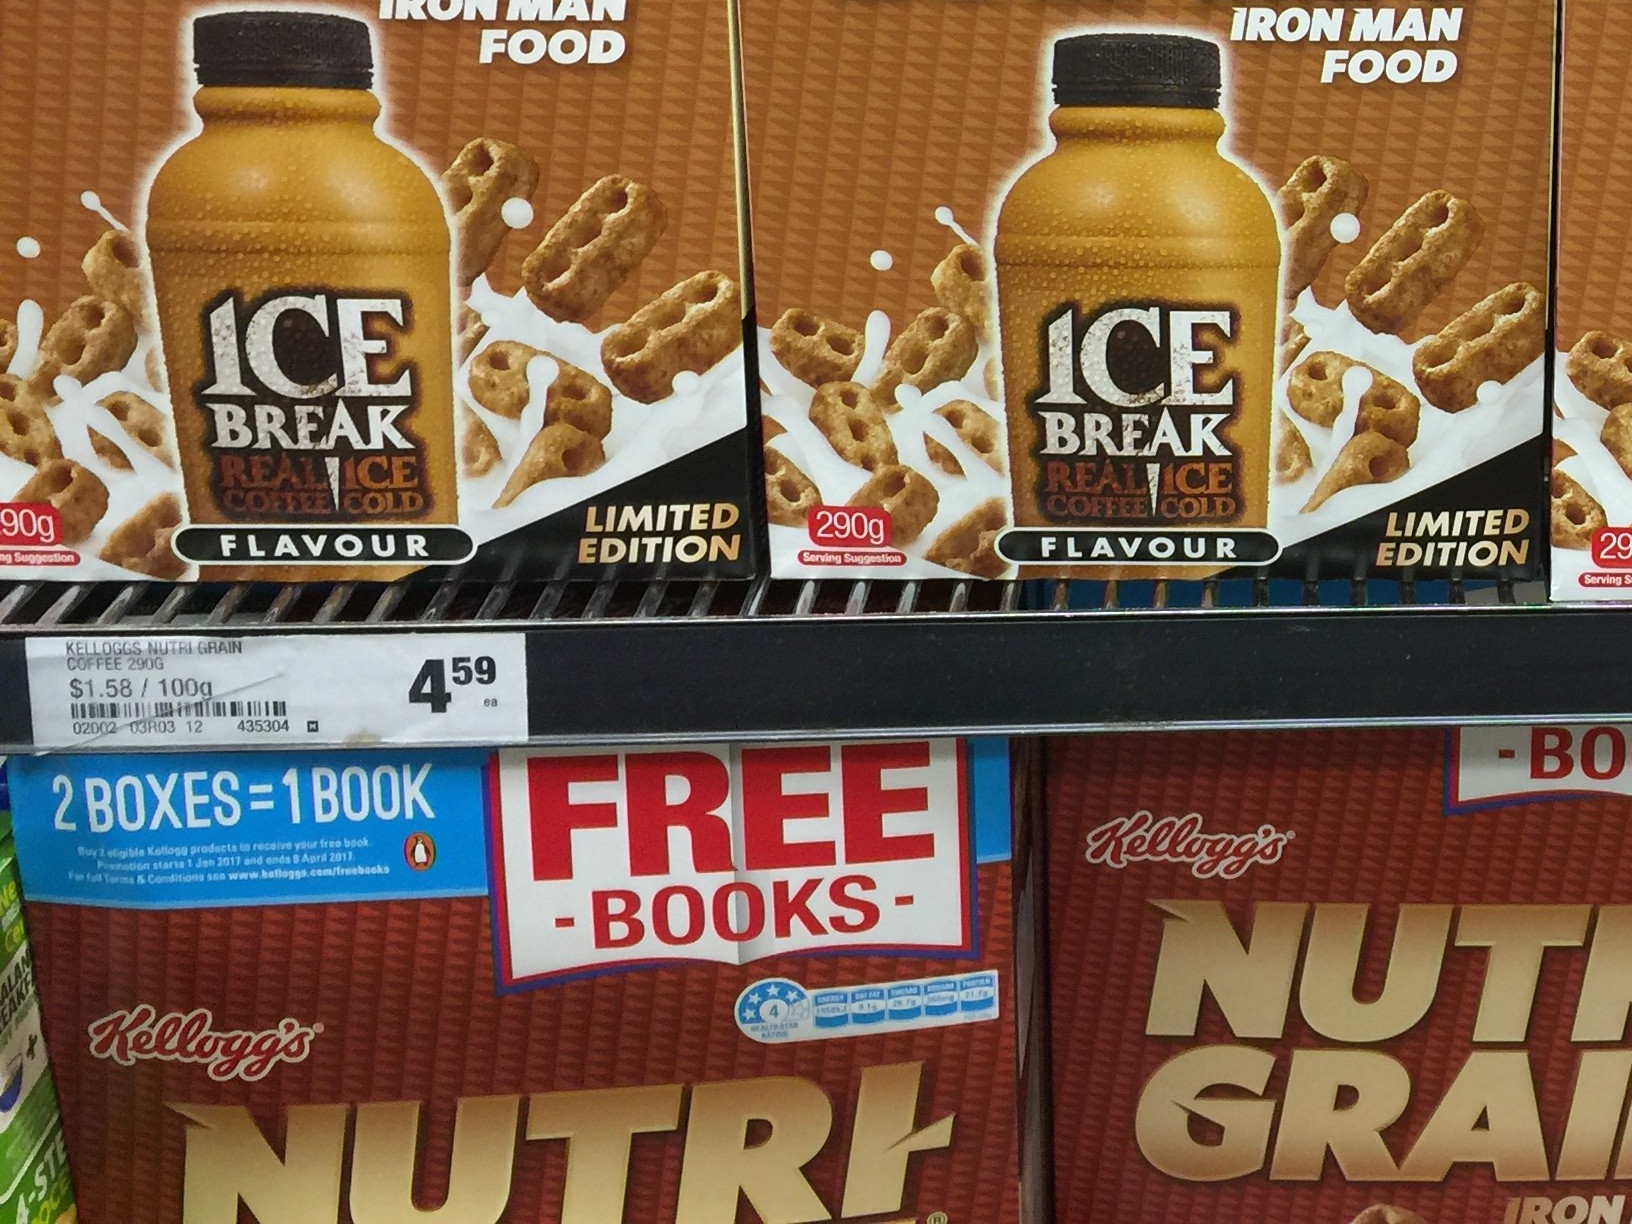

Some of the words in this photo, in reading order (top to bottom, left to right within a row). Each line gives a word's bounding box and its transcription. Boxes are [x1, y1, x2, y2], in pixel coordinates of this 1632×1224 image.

[1229, 6, 1348, 42] IRON
[1348, 6, 1463, 42] MAN
[479, 29, 627, 65] FOOD
[1320, 47, 1458, 84] FOOD
[202, 295, 413, 399] ICE
[1034, 307, 1239, 409] ICE
[212, 400, 416, 451] BREAK
[1037, 410, 1234, 460] BREAK
[1045, 460, 1147, 497] REAL
[1161, 460, 1234, 495] ICE
[585, 503, 740, 535] LIMITED
[1046, 493, 1149, 519] COFFEE
[1159, 493, 1237, 519] COLD
[0, 508, 55, 543] 90g
[815, 511, 885, 547] 290g
[1385, 509, 1530, 539] LIMITED
[14, 552, 75, 564] Suggestion
[220, 532, 430, 559] FLAVOUR
[577, 534, 741, 564] EDITION
[802, 551, 842, 565] Serving
[844, 552, 903, 565] Suggestion
[1039, 535, 1238, 560] FLAVOUR
[1375, 538, 1530, 567] EDITION
[1583, 573, 1619, 588] Serving
[66, 641, 142, 656] KELLOGGS
[147, 641, 193, 656] NUTRI
[198, 641, 242, 655] GRAIN
[67, 657, 122, 671] COFFEE
[128, 657, 165, 671] 290G
[69, 678, 133, 699] $1.58
[483, 696, 498, 708] ea
[72, 721, 117, 735] 02002
[130, 721, 176, 734] 03R03
[186, 721, 202, 733] 12
[237, 720, 289, 733] 435304
[52, 774, 76, 832] 2
[86, 770, 241, 833] BOXES
[313, 763, 436, 822] BOOK
[526, 741, 935, 881] FREE
[191, 843, 237, 856] products
[1085, 810, 1287, 880] Kellogg's
[217, 856, 241, 866] 2017
[88, 1004, 315, 1082] Kellogg's
